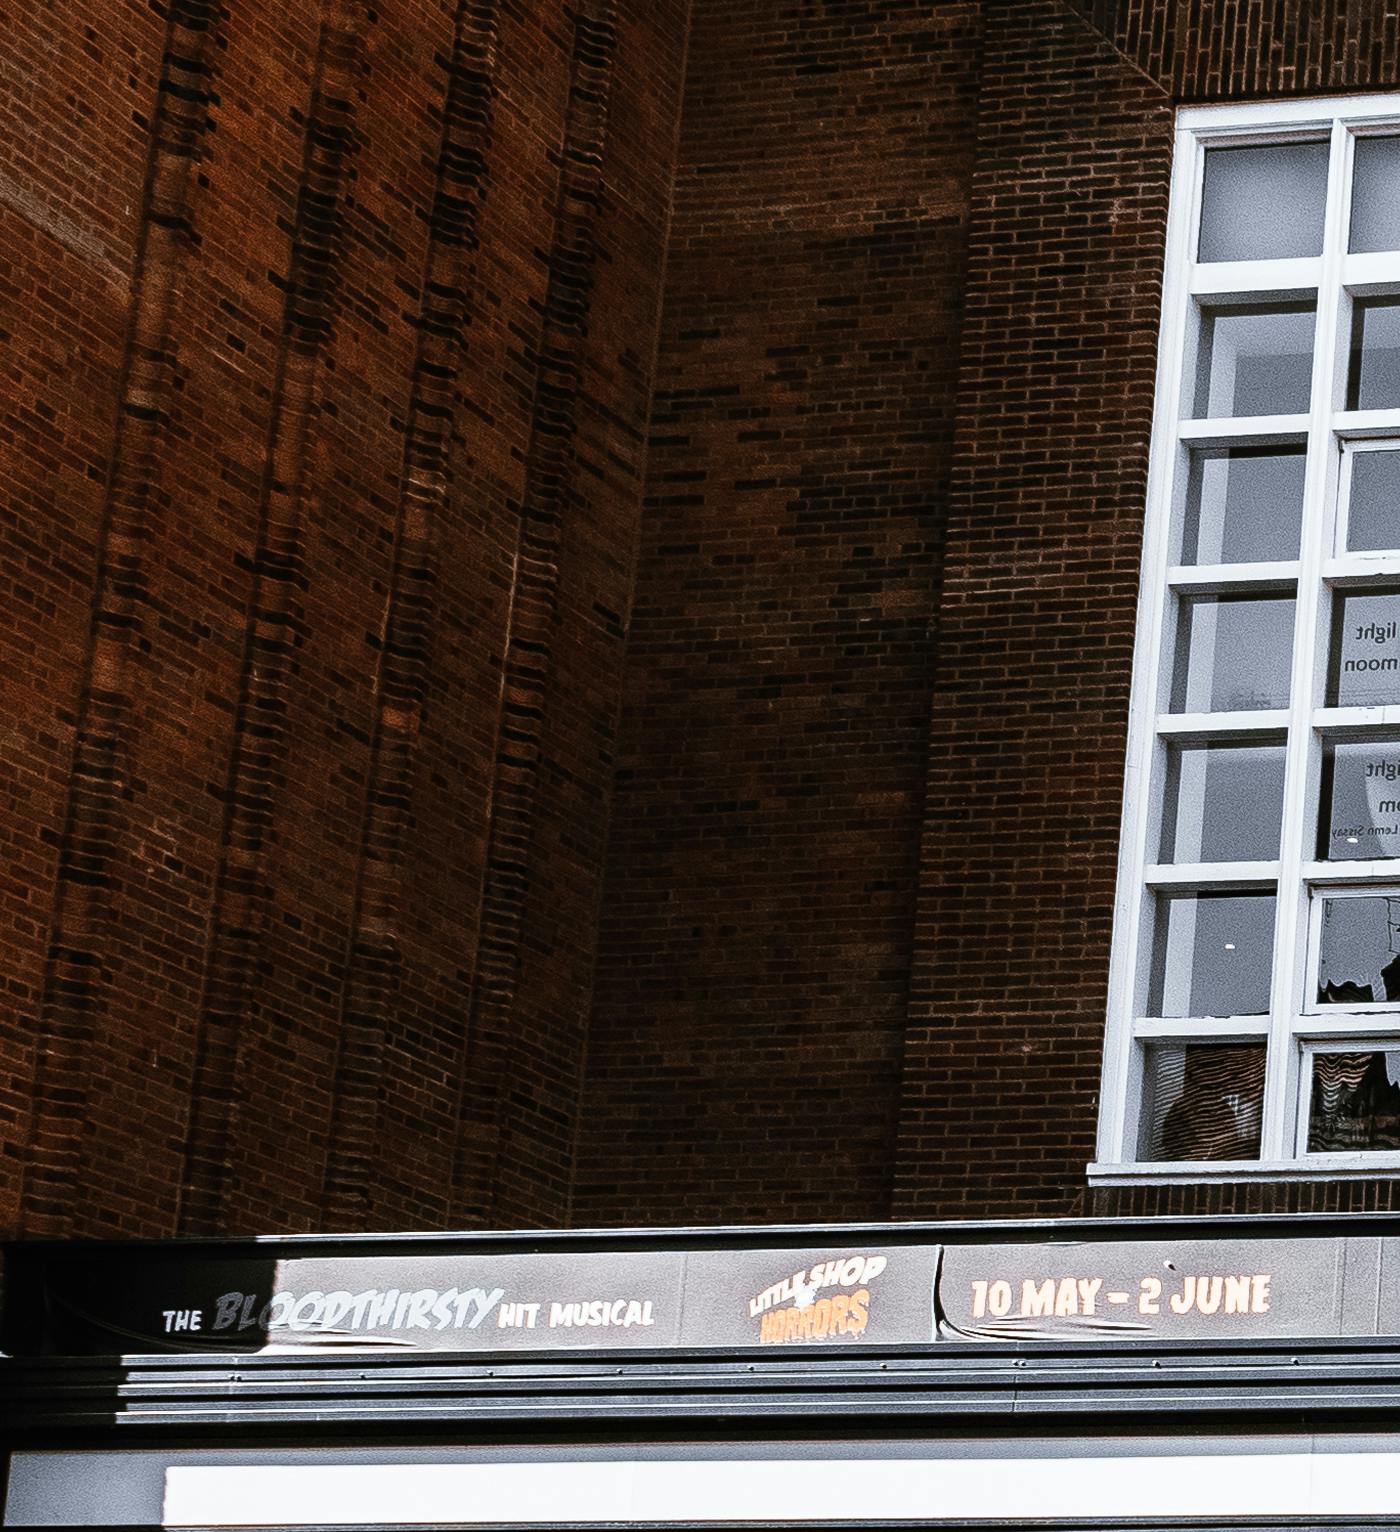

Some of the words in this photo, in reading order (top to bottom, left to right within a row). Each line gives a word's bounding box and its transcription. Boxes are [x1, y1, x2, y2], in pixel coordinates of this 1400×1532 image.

[163, 1310, 202, 1333] THE
[215, 1286, 505, 1332] BLOODTHIRSTY
[499, 1302, 541, 1329] HIT
[549, 1300, 655, 1329] MUSICAL
[749, 1268, 810, 1317] LITTLE
[808, 1256, 888, 1291] SHOP
[971, 1280, 1005, 1319] 10
[1021, 1278, 1102, 1317] MAY
[1138, 1278, 1162, 1314] 2
[1171, 1275, 1271, 1315] JUNE
[759, 1289, 870, 1344] HORRORS
